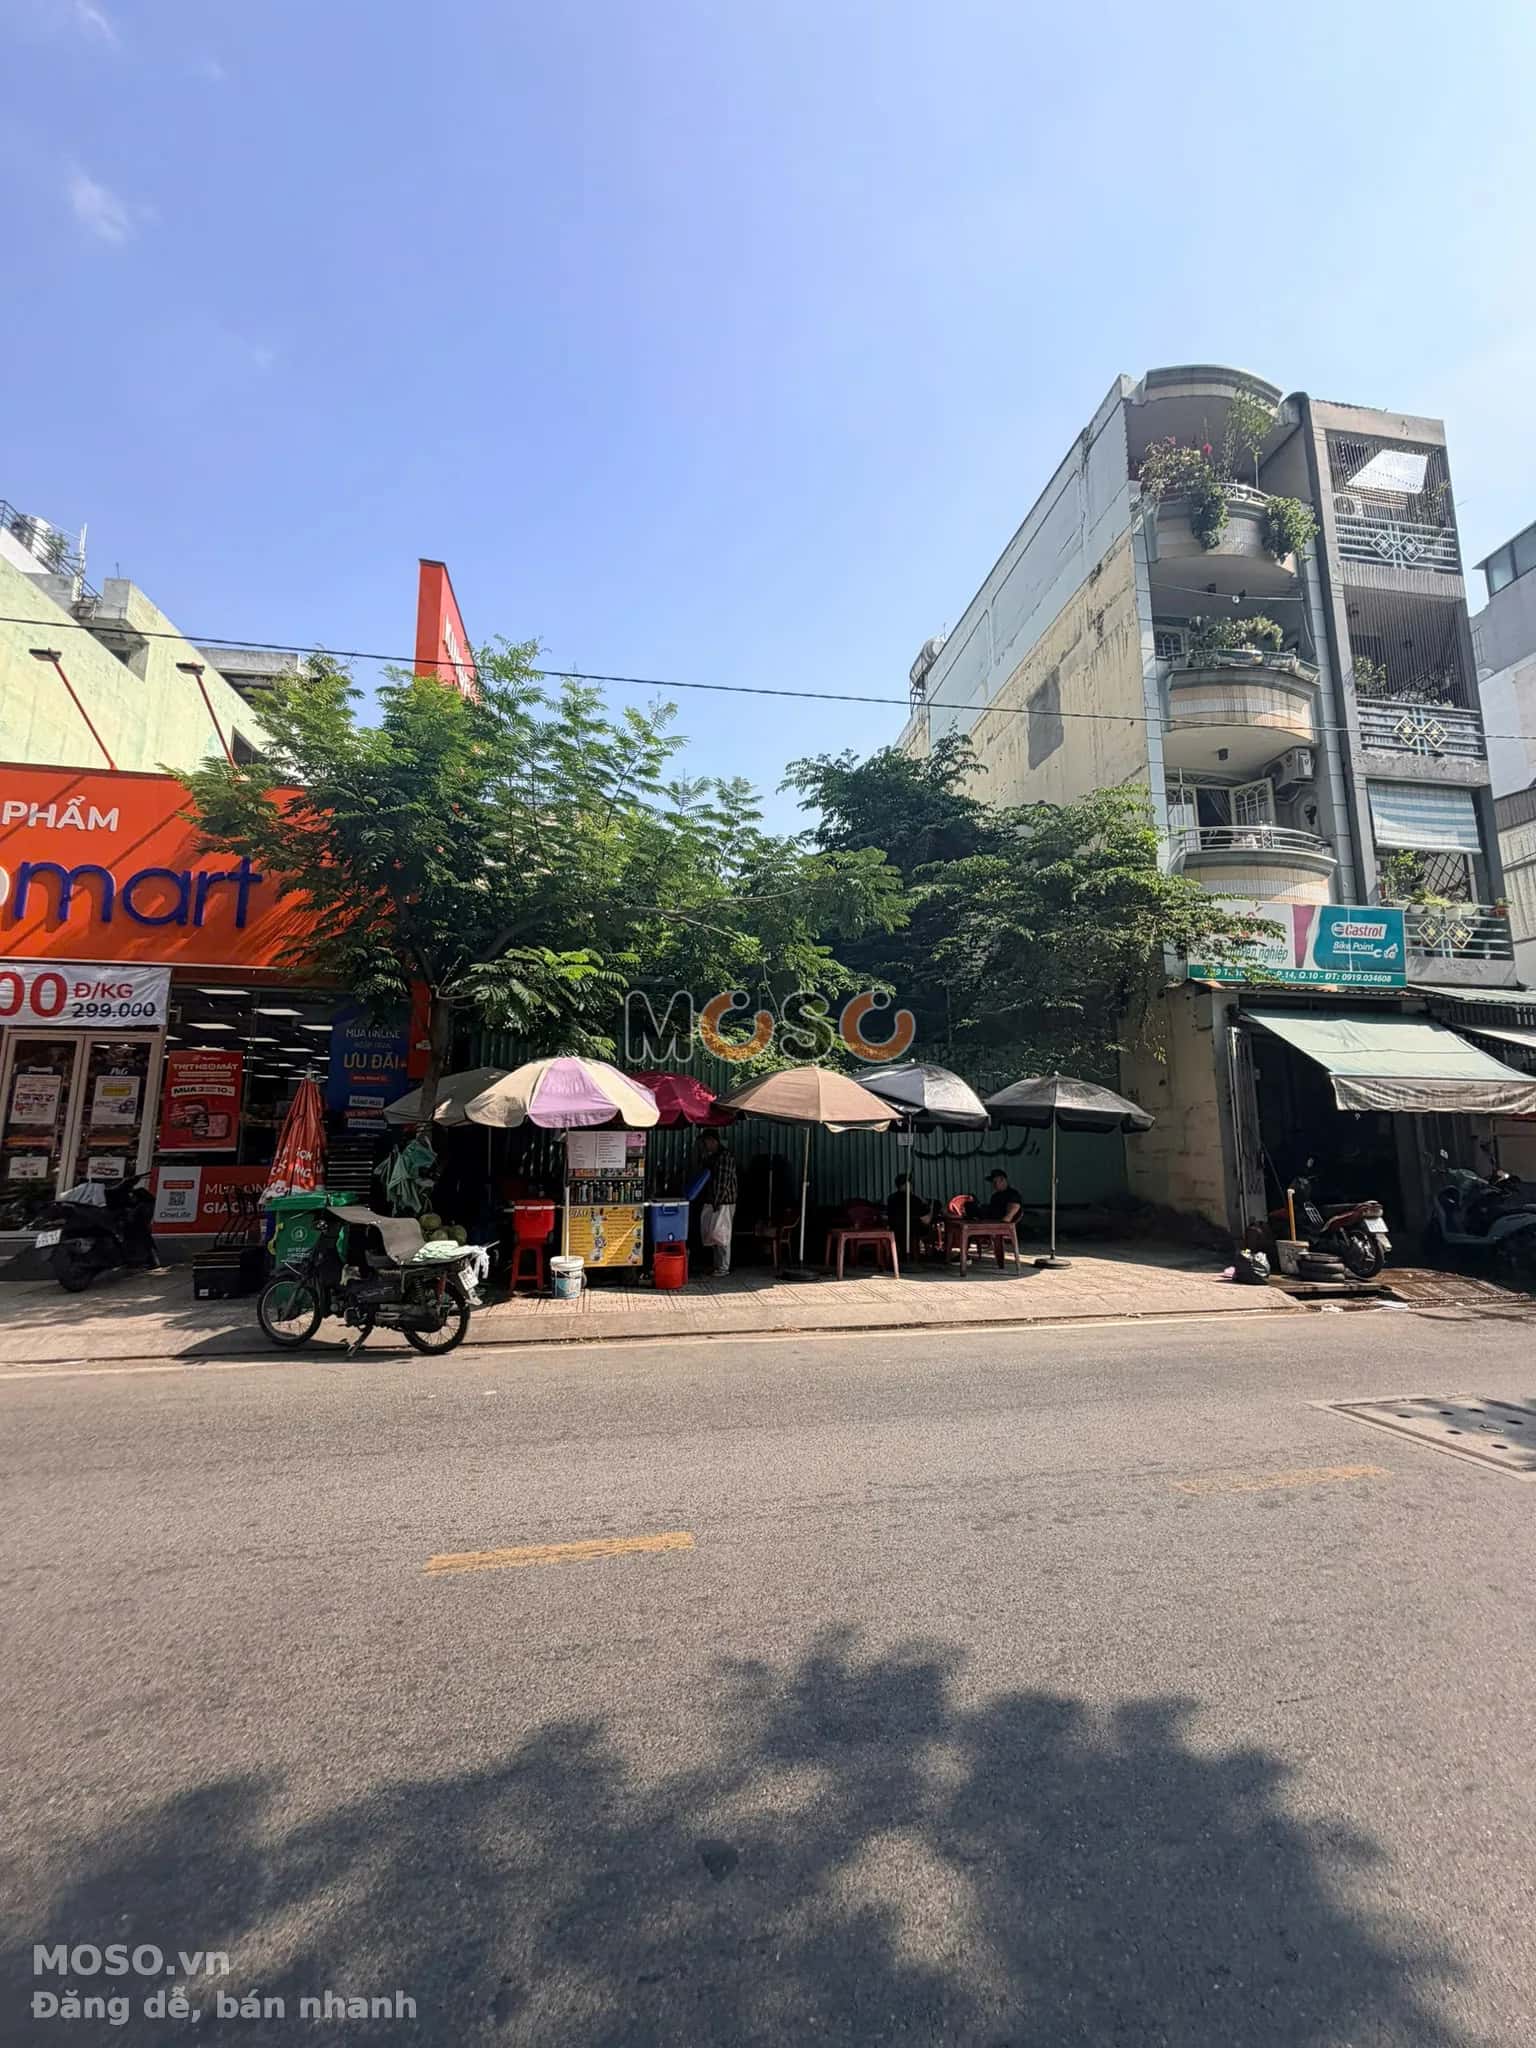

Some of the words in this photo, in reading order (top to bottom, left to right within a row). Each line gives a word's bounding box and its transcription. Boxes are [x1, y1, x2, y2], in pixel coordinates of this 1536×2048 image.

[2, 795, 119, 832] PHẨM
[0, 856, 263, 929] mart
[1345, 924, 1384, 937] Castrol
[1334, 940, 1351, 951] Bike
[1352, 941, 1375, 951] Point
[73, 982, 134, 999] Đ/KG
[72, 1002, 156, 1018] 299.000
